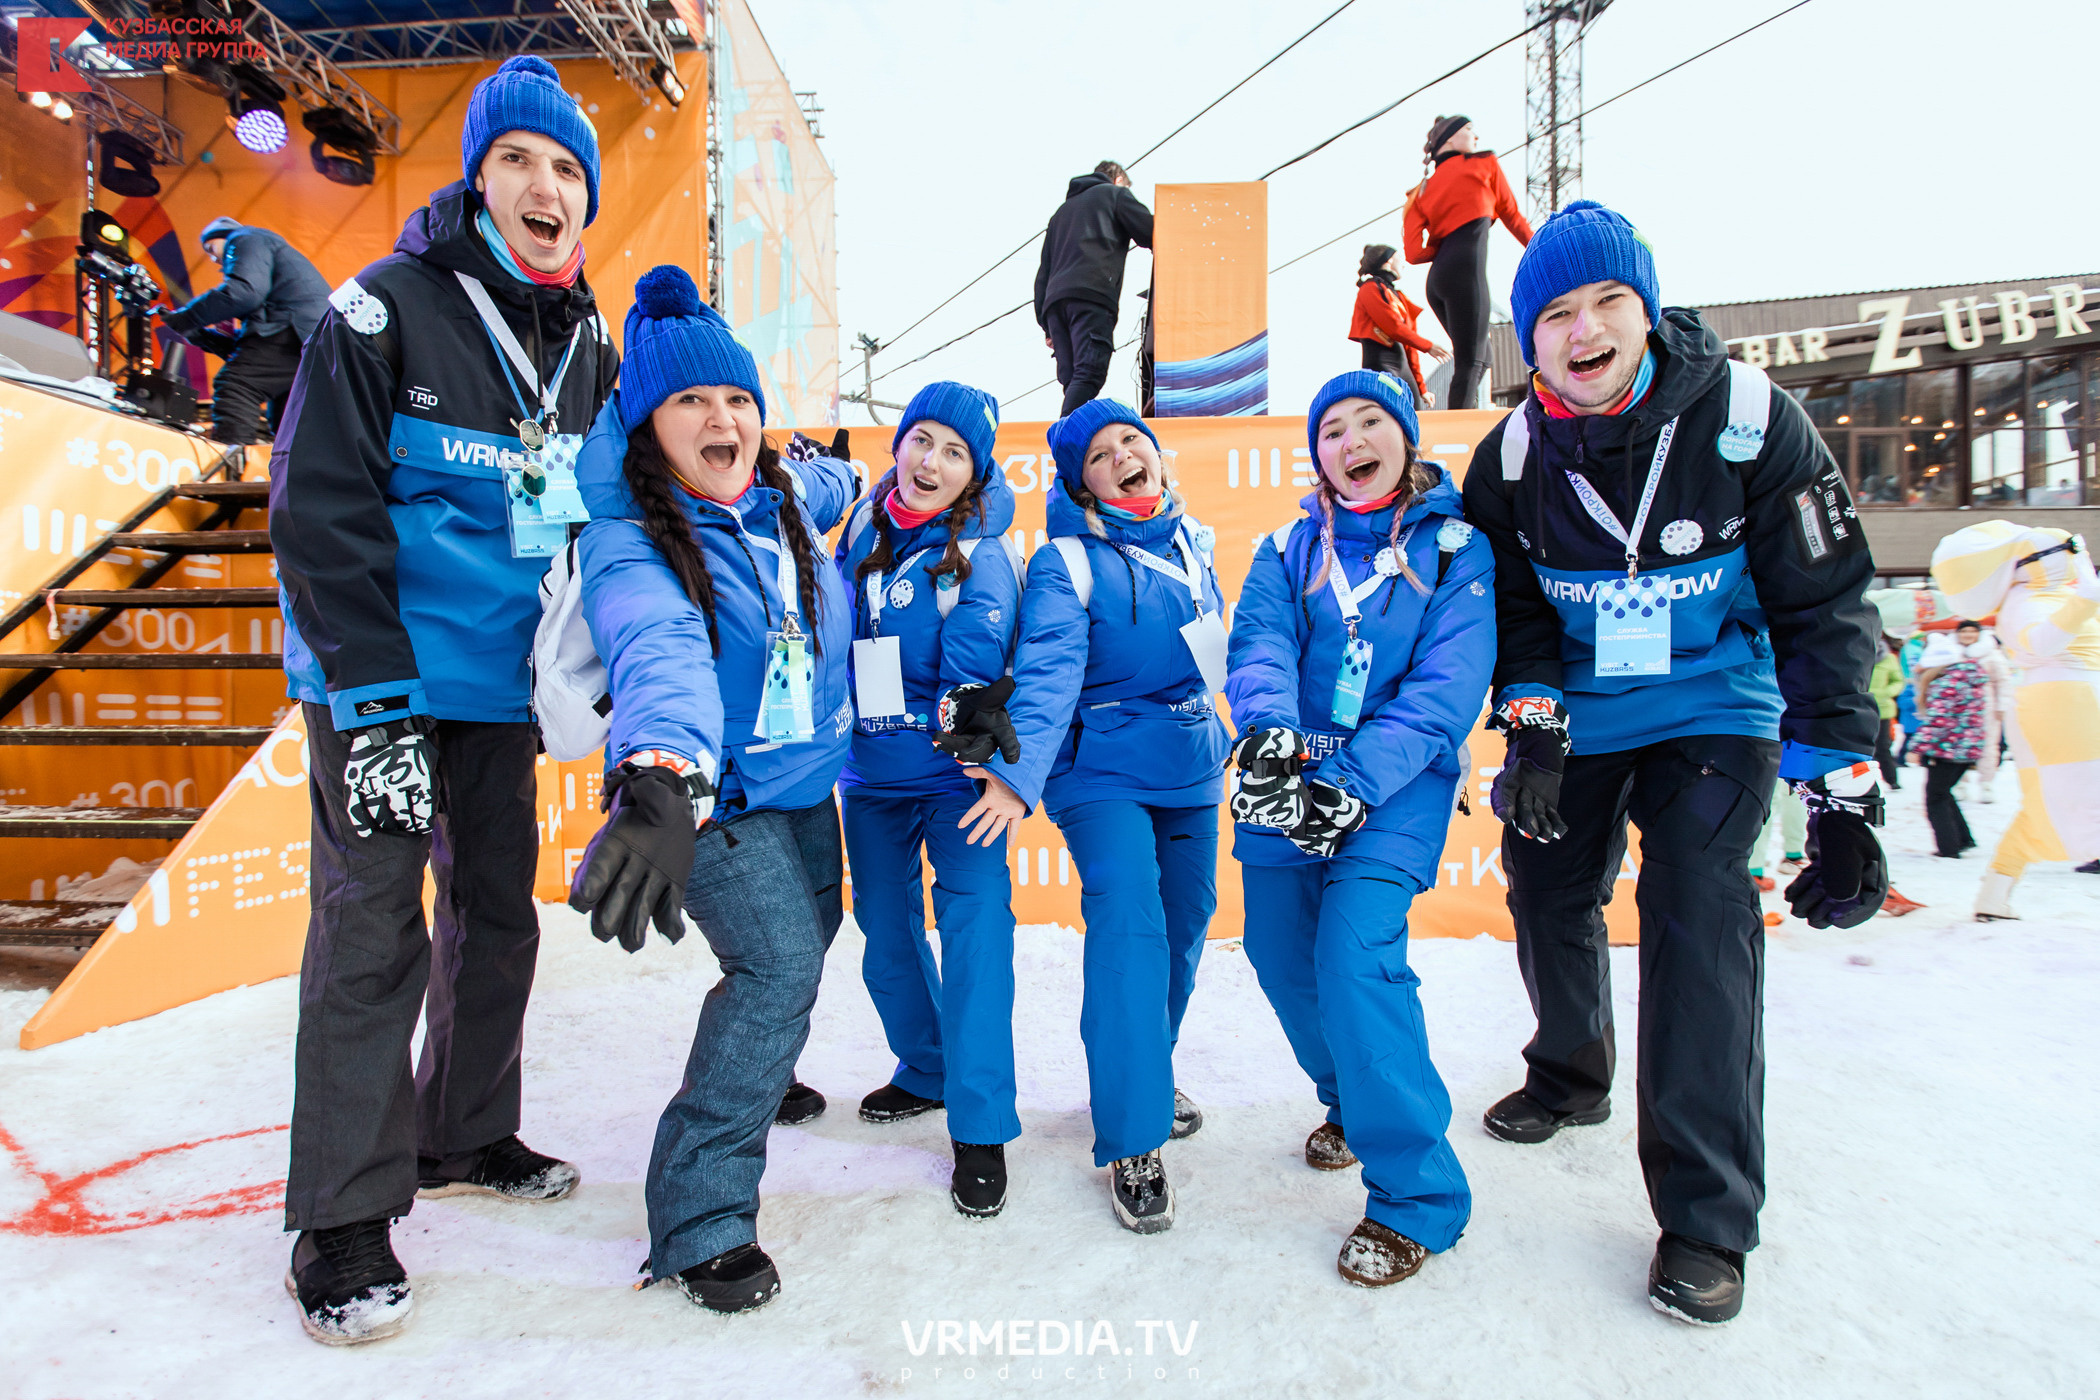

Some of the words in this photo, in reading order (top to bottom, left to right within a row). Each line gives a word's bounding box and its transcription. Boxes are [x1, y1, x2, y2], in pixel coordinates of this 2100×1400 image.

[1742, 330, 1830, 370] BAR
[1857, 283, 2093, 374] ZUBR
[407, 389, 439, 406] TRD
[1167, 698, 1197, 712] VISIT
